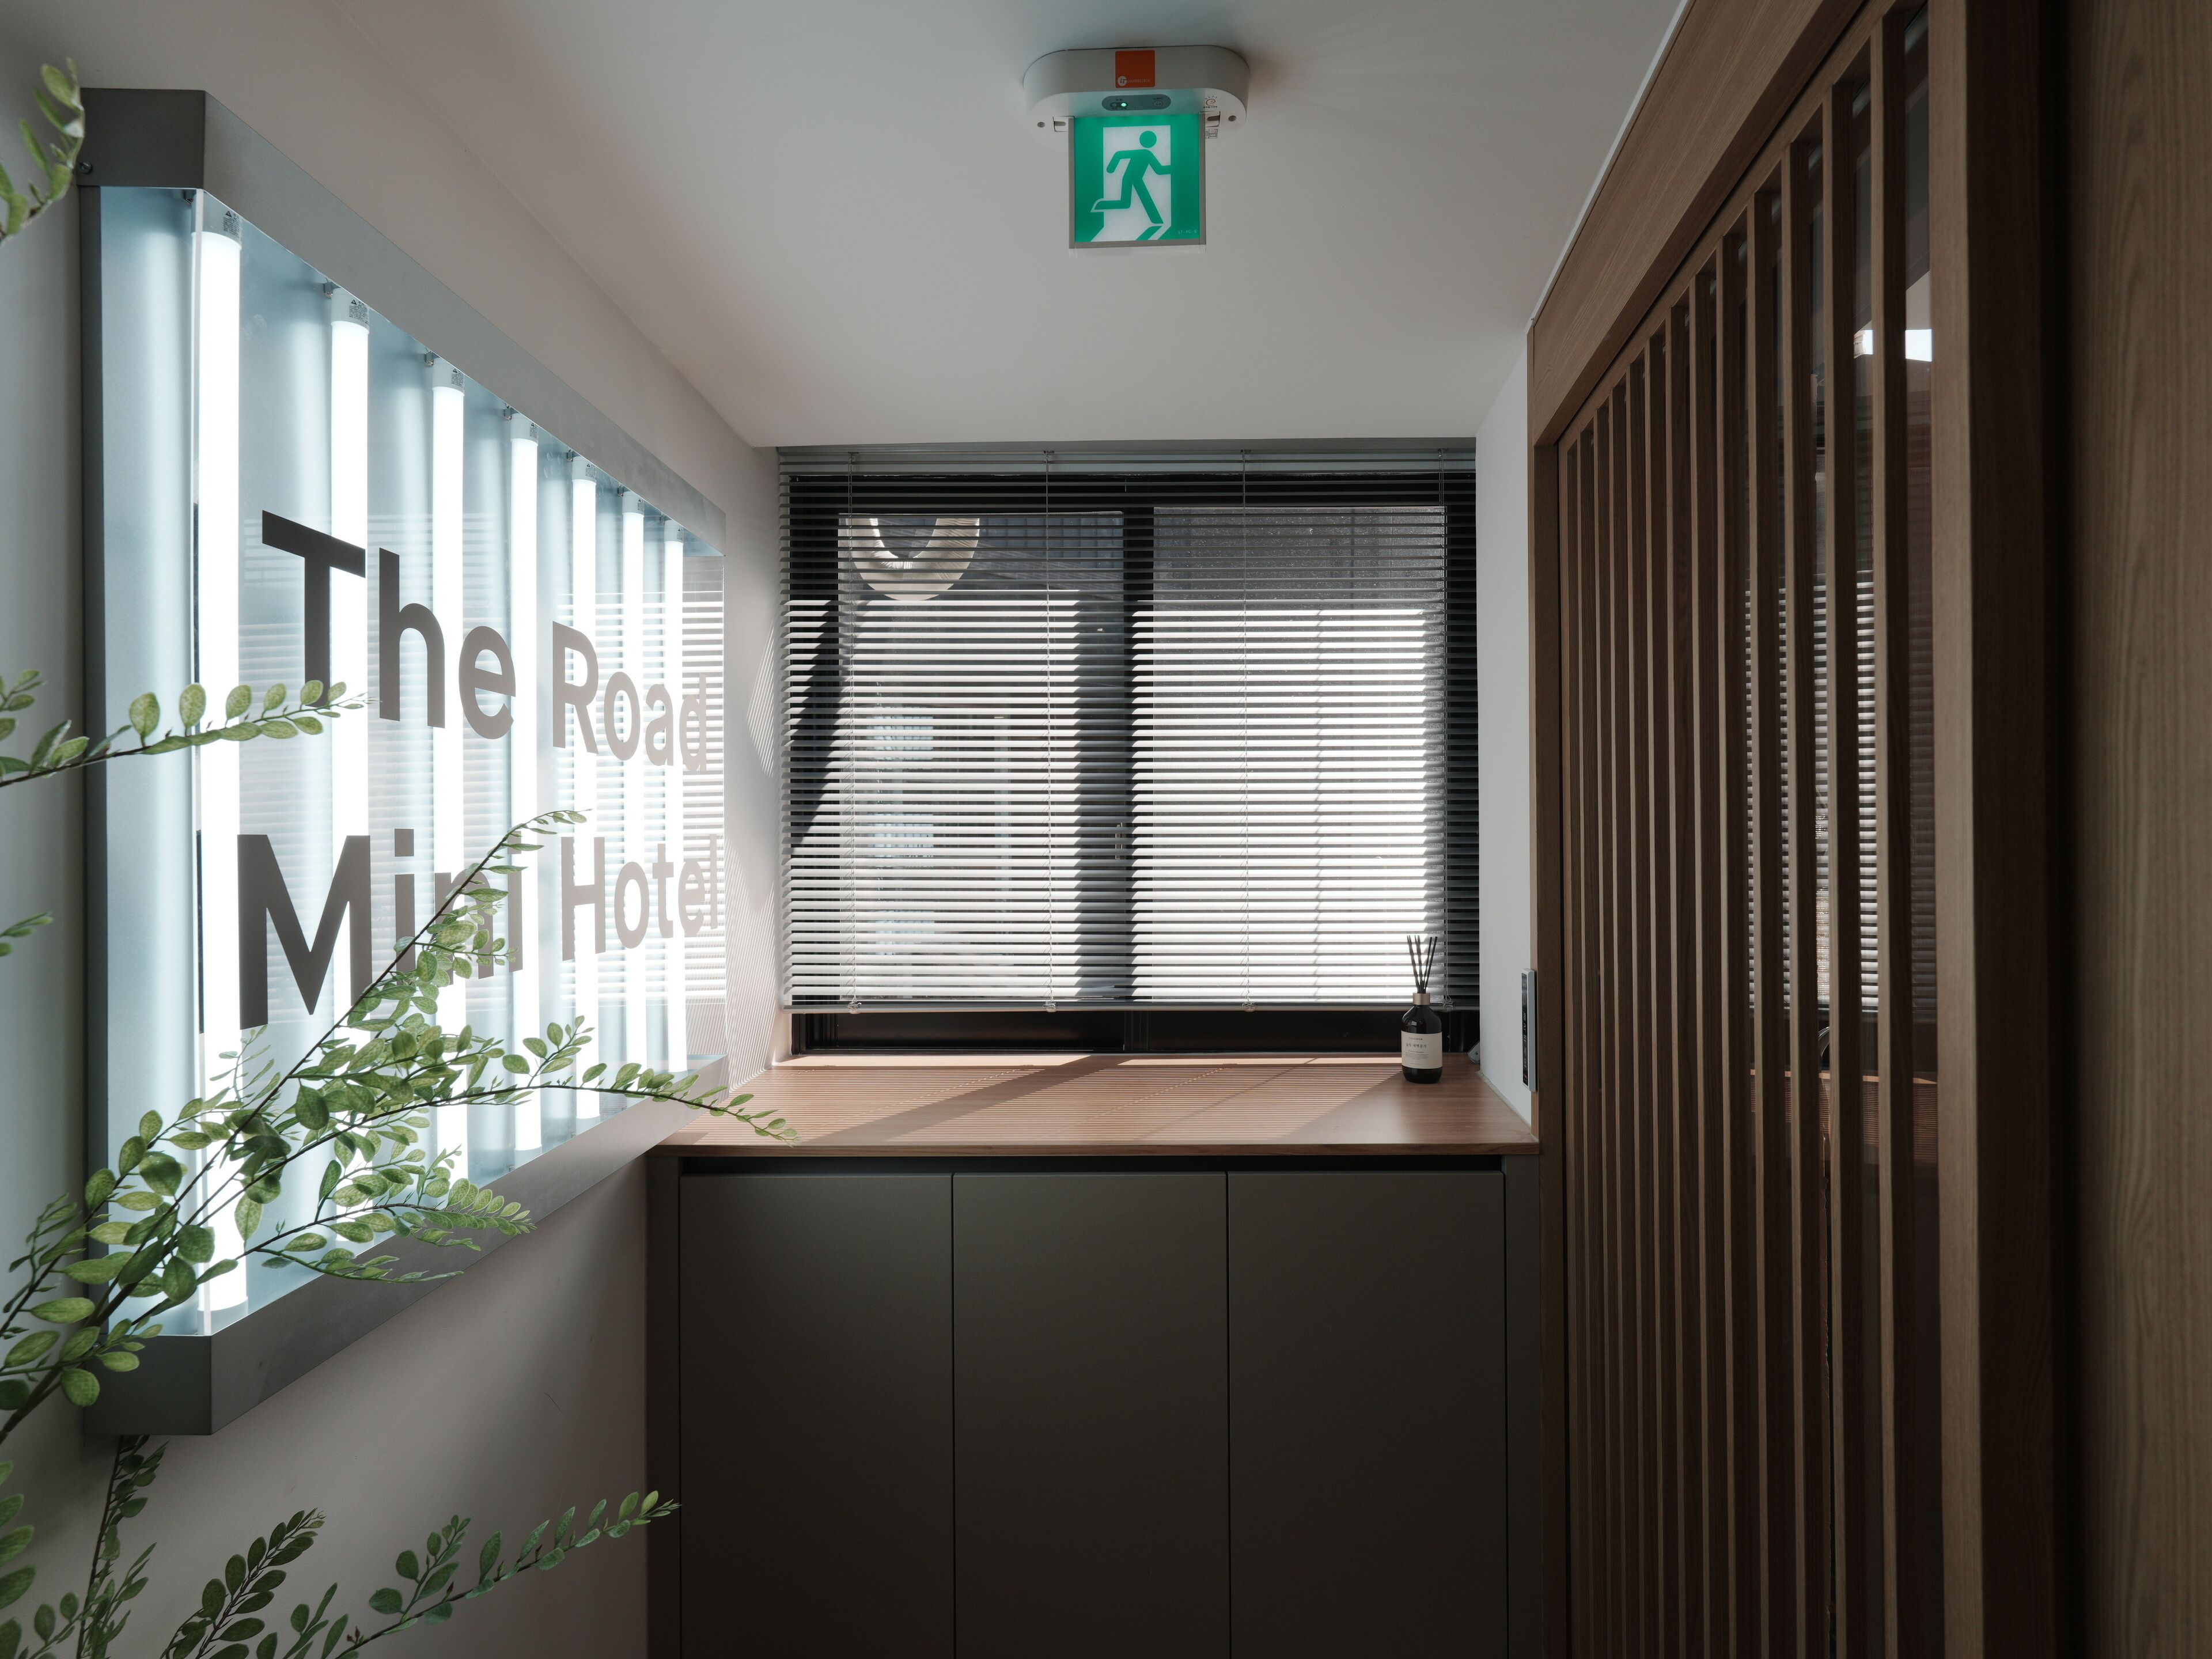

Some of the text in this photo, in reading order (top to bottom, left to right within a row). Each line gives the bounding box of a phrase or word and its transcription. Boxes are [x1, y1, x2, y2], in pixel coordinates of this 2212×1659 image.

[262, 510, 707, 772] The Road
[237, 828, 718, 1030] Mini Hotel
